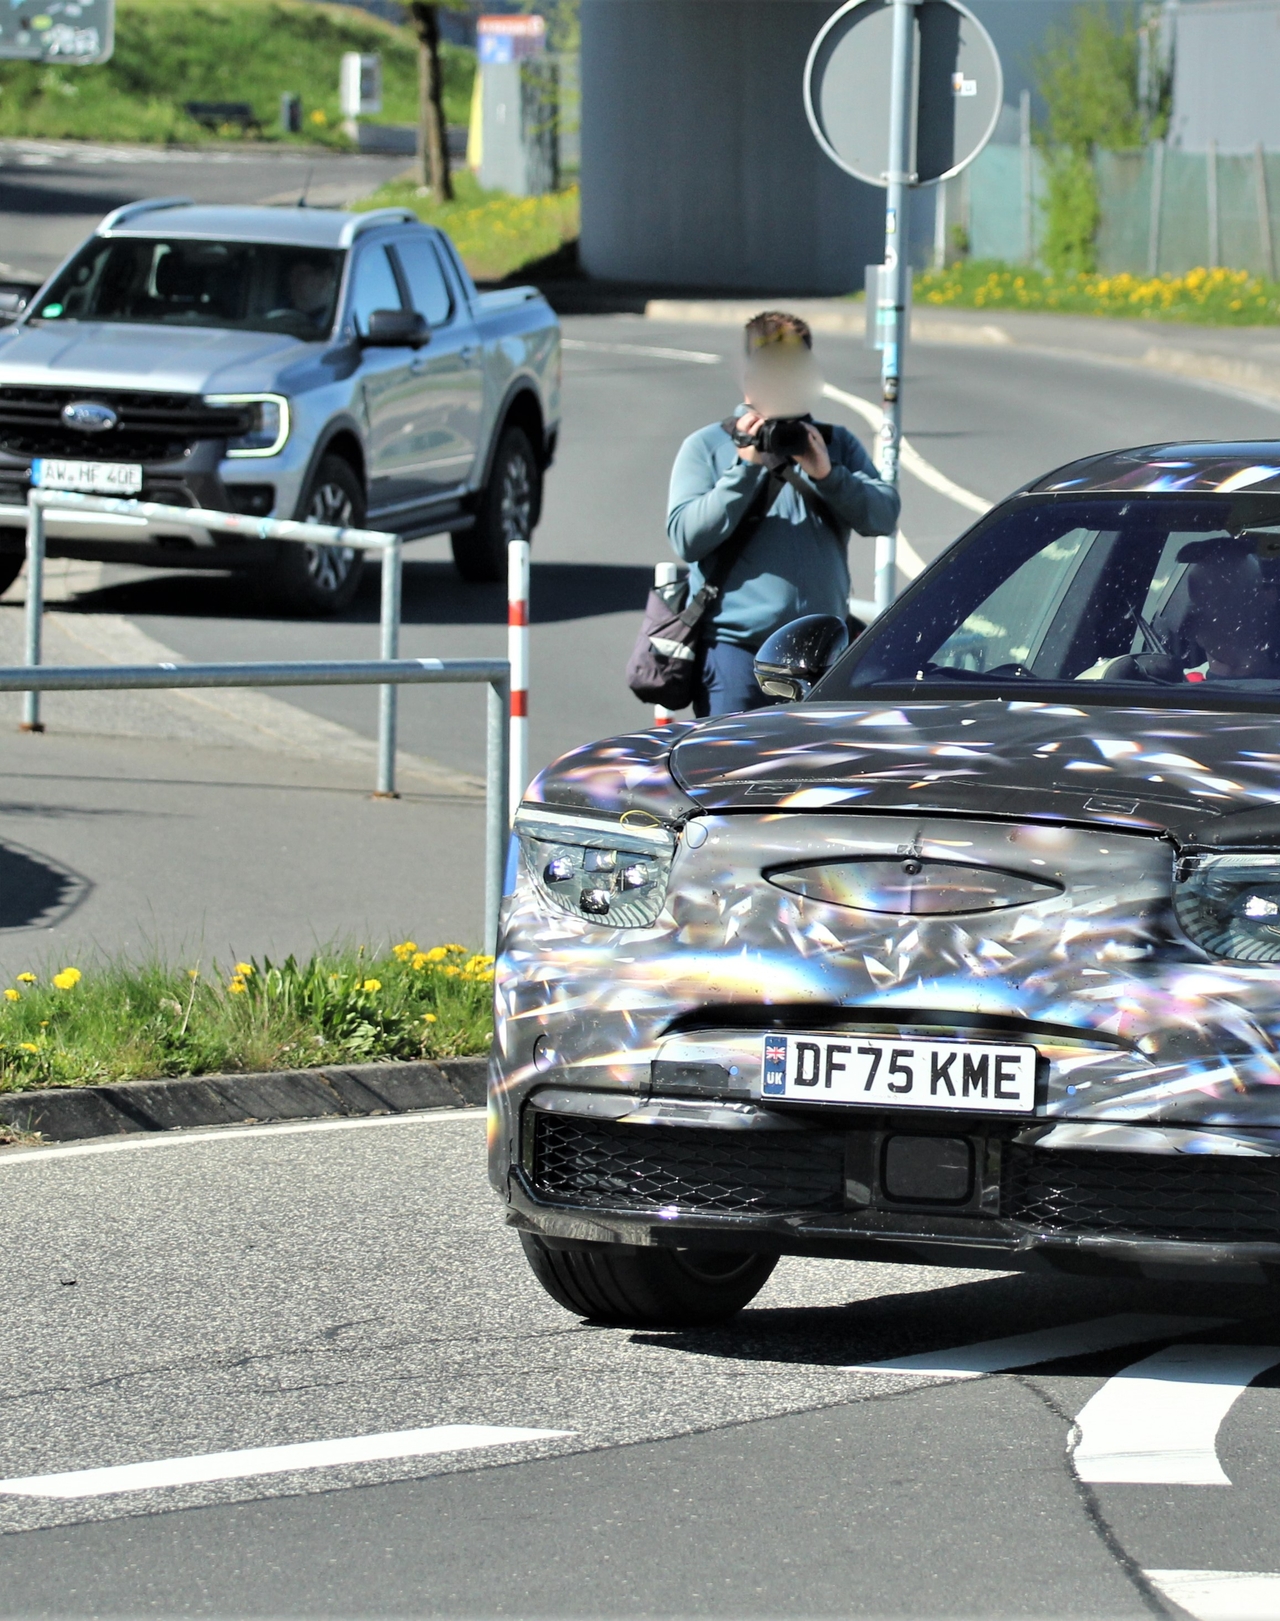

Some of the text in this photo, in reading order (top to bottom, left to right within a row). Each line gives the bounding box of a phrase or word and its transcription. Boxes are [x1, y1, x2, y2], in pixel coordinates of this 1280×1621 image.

[767, 1072, 784, 1085] UK
[794, 1041, 1021, 1099] DF75 KME
